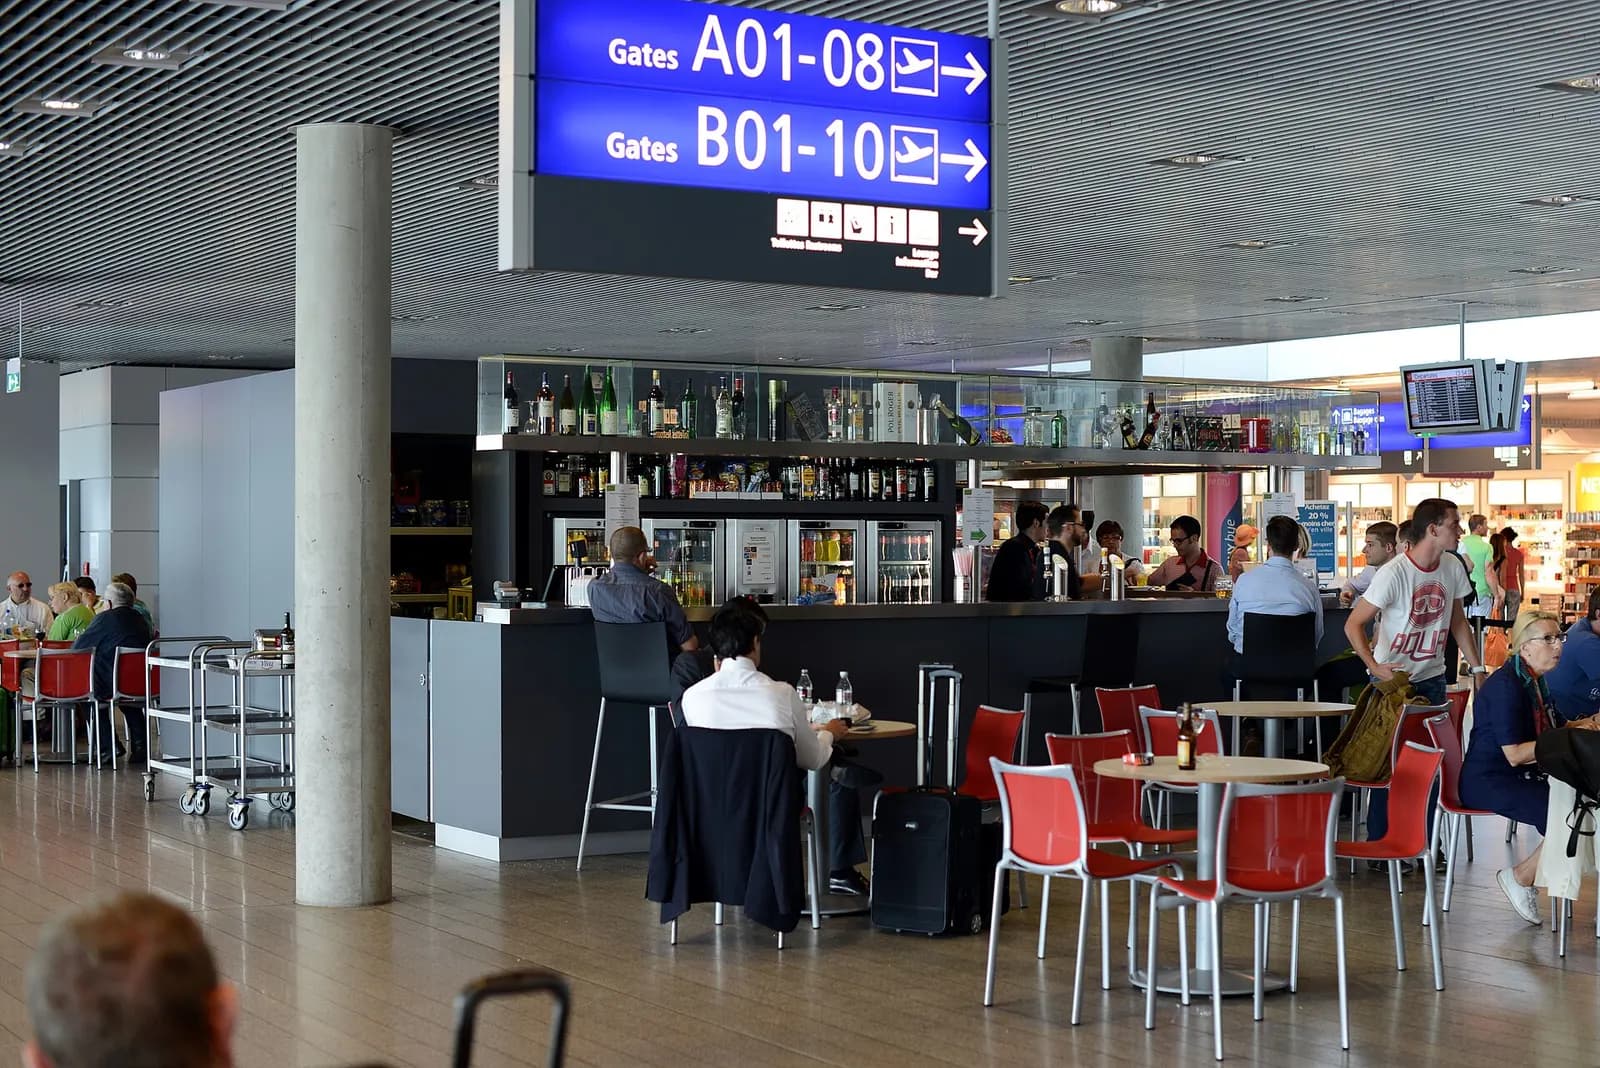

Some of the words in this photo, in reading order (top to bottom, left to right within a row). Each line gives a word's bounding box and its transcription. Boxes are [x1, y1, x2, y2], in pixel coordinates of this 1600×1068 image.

[609, 38, 678, 69] Gates
[692, 14, 886, 91] A01-08
[606, 132, 679, 163] Gates
[697, 105, 885, 181] B01-10
[1390, 629, 1449, 662] AQUA
